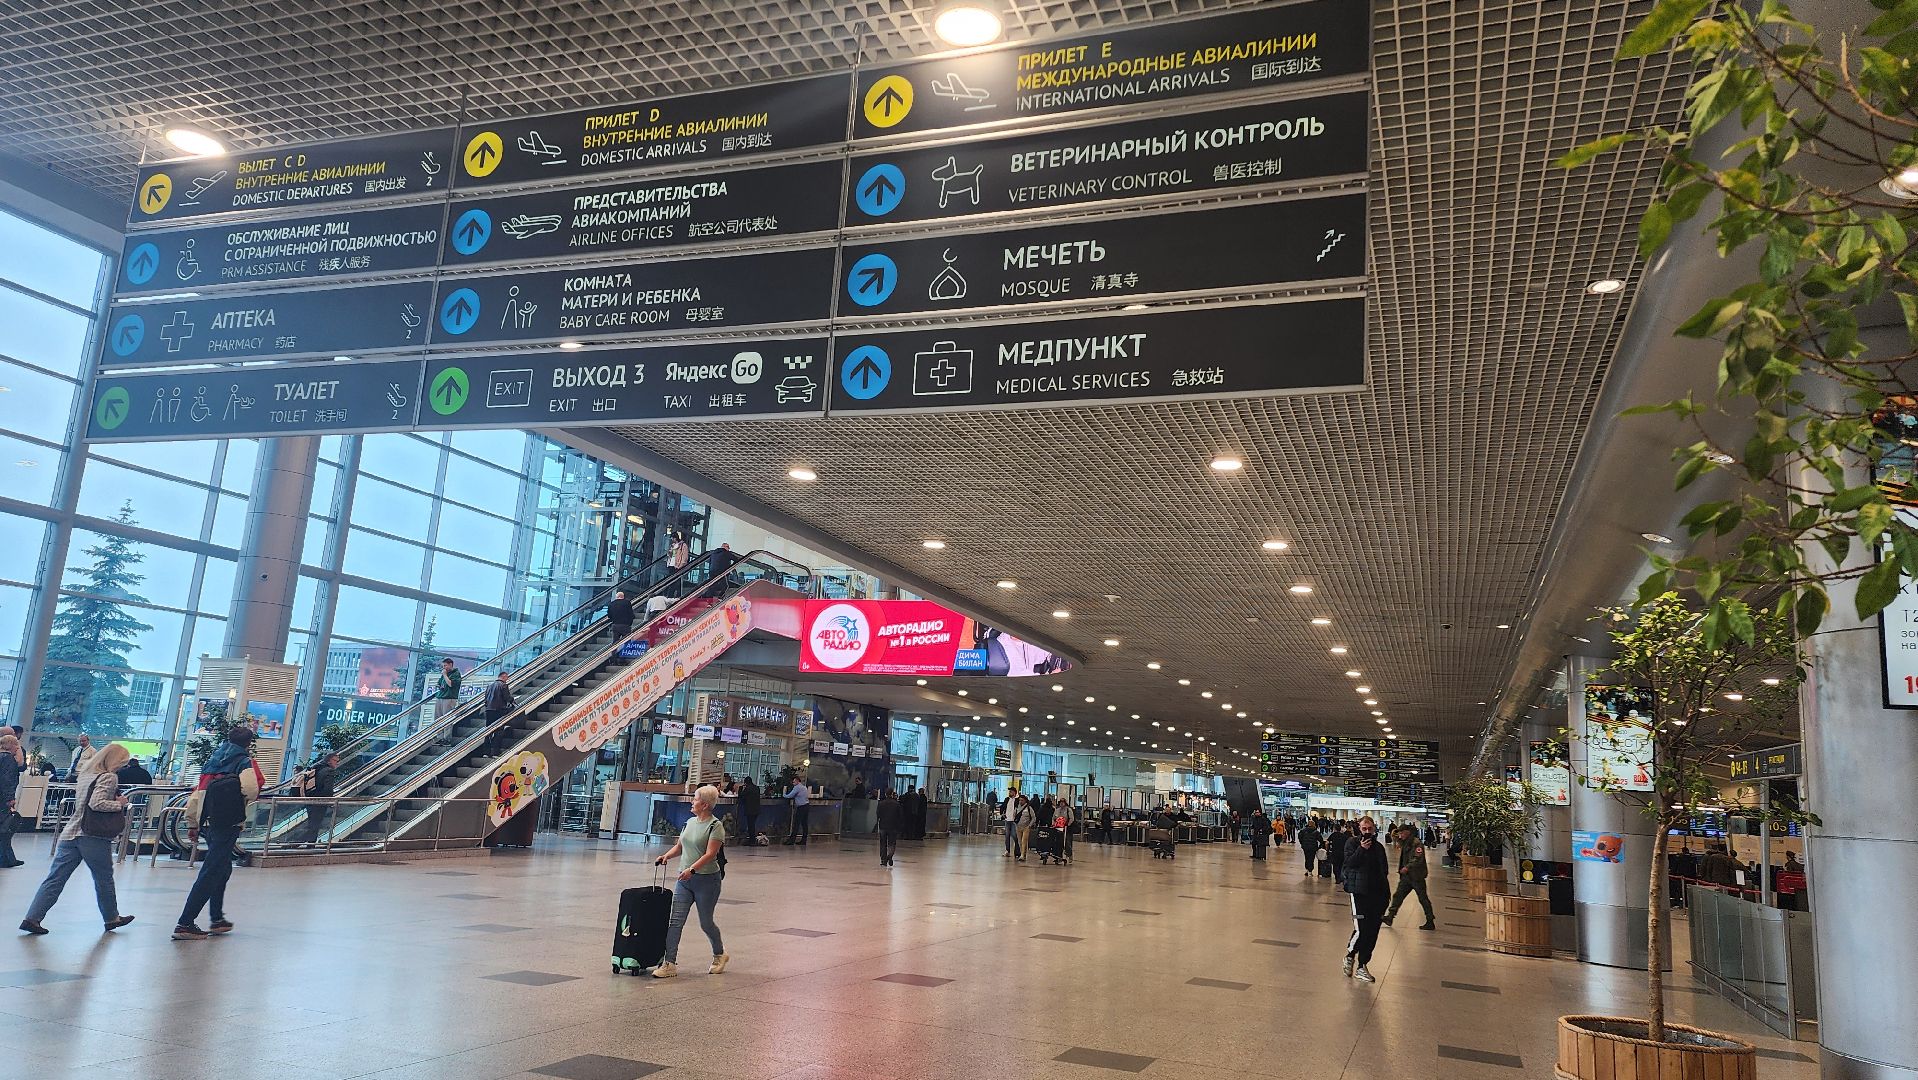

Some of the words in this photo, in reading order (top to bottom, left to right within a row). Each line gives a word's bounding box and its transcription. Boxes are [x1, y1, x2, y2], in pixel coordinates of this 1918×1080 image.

[1016, 51, 1186, 91] МЕЖДУНАРОДНЫЕ
[1190, 32, 1317, 67] АВИАЛИНИИ
[1017, 45, 1087, 71] ПРИЛЕТ
[1251, 55, 1323, 82] 国际到达
[1015, 79, 1144, 111] INTERNATIONAL
[1147, 68, 1230, 93] ARRIVALS
[585, 110, 640, 131] ПРИЛЕТ
[650, 108, 660, 122] D
[583, 124, 673, 150] ВНУТРЕННИЕ
[676, 112, 768, 138] АВИАЛИНИИ
[722, 133, 773, 151] 国内到达
[1010, 128, 1188, 174] ВЕТЕРИНАРНЫЙ
[1195, 115, 1325, 150] КОНТРОЛЬ
[581, 148, 643, 167] DOMESTIC
[646, 139, 707, 159] ARRIVALS
[239, 158, 276, 174] ВЫЛЕТ
[297, 154, 306, 167] D
[1213, 158, 1282, 182] 兽医控制
[235, 169, 308, 189] ВНУТРЕННИЕ
[311, 161, 385, 181] АВИАЛИНИИ
[364, 176, 407, 193] 国内出发
[426, 176, 433, 187] 2
[232, 190, 284, 206] DOMESTIC
[286, 182, 353, 202] DEPARTURES
[574, 181, 728, 211] ПРЕДСТАВИТЕЛЬСТВА
[1009, 177, 1106, 204] VETERINARY
[1111, 168, 1193, 193] CONTROL
[571, 202, 692, 229] АВИАКОМПАНИЙ
[228, 225, 321, 245] ОБСЛУЖИВАНИЕ
[323, 221, 350, 238] ЛИЦ
[569, 230, 618, 247] AIRLINE
[621, 225, 674, 242] OFFICES
[688, 217, 778, 237] 航空公司代表处
[224, 249, 233, 261] С
[235, 239, 329, 260] ОГРАНИЧЕННОЙ
[330, 229, 437, 252] ПОДВИЖНОСТЬЮ
[1003, 240, 1106, 271] МЕЧЕТЬ
[221, 265, 243, 279] PRM
[244, 259, 306, 276] ASSISTANCE
[318, 256, 371, 271] 残疾人服务
[564, 273, 632, 292] КОМНАТА
[1001, 277, 1071, 299] MOSQUE
[1090, 272, 1140, 292] 清真寺
[561, 292, 619, 310] МАТЕРИ
[621, 291, 633, 306] И
[636, 287, 701, 305] РЕБЕНКА
[211, 309, 276, 330] АПТЕКА
[559, 314, 593, 329] BABY
[595, 312, 627, 327] CARE
[630, 309, 670, 325] ROOM
[685, 306, 725, 322] 母婴室
[208, 337, 264, 352] PHARMACY
[275, 335, 297, 349] 药店
[405, 329, 412, 340] 2
[997, 333, 1147, 369] МЕДПУНКТ
[552, 363, 627, 389] ВЫХОД
[633, 363, 645, 385] 3
[665, 362, 728, 383] Яндекс
[735, 357, 760, 379] Go
[1171, 367, 1225, 388] 急救站
[274, 380, 340, 402] ТУАЛЕТ
[494, 381, 525, 397] EXIT
[996, 375, 1067, 395] MEDICAL
[1072, 371, 1151, 391] SERVICES
[549, 398, 578, 413] EXIT
[592, 397, 617, 412] 出口
[663, 394, 693, 409] TAXI
[709, 393, 747, 408] 出租车
[270, 410, 307, 423] TOILET
[315, 408, 348, 423] 洗手间
[391, 409, 398, 420] 2
[816, 629, 846, 640] АВТО
[877, 620, 944, 637] АВТОРАДИО
[823, 640, 861, 651] РАДИО
[890, 636, 905, 648] №1
[912, 632, 950, 646] РОССИИ
[558, 704, 593, 735] ЛЮБИМЫЕ
